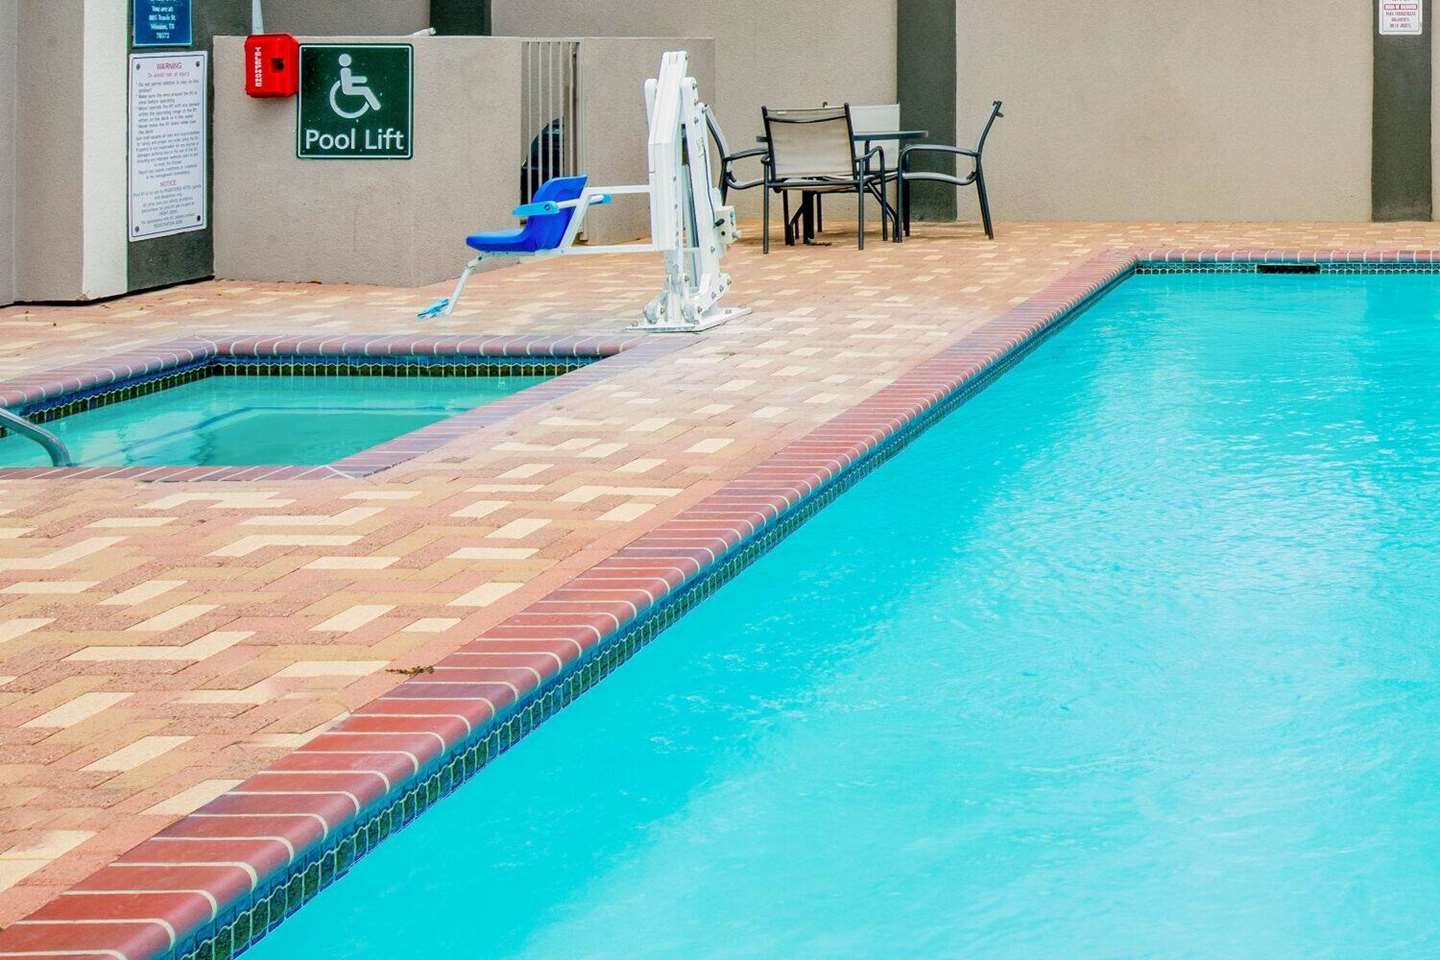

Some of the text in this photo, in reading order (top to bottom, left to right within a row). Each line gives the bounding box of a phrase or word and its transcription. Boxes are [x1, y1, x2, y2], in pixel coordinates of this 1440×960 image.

[156, 62, 182, 70] WARNING
[305, 128, 405, 150] Pool Lift
